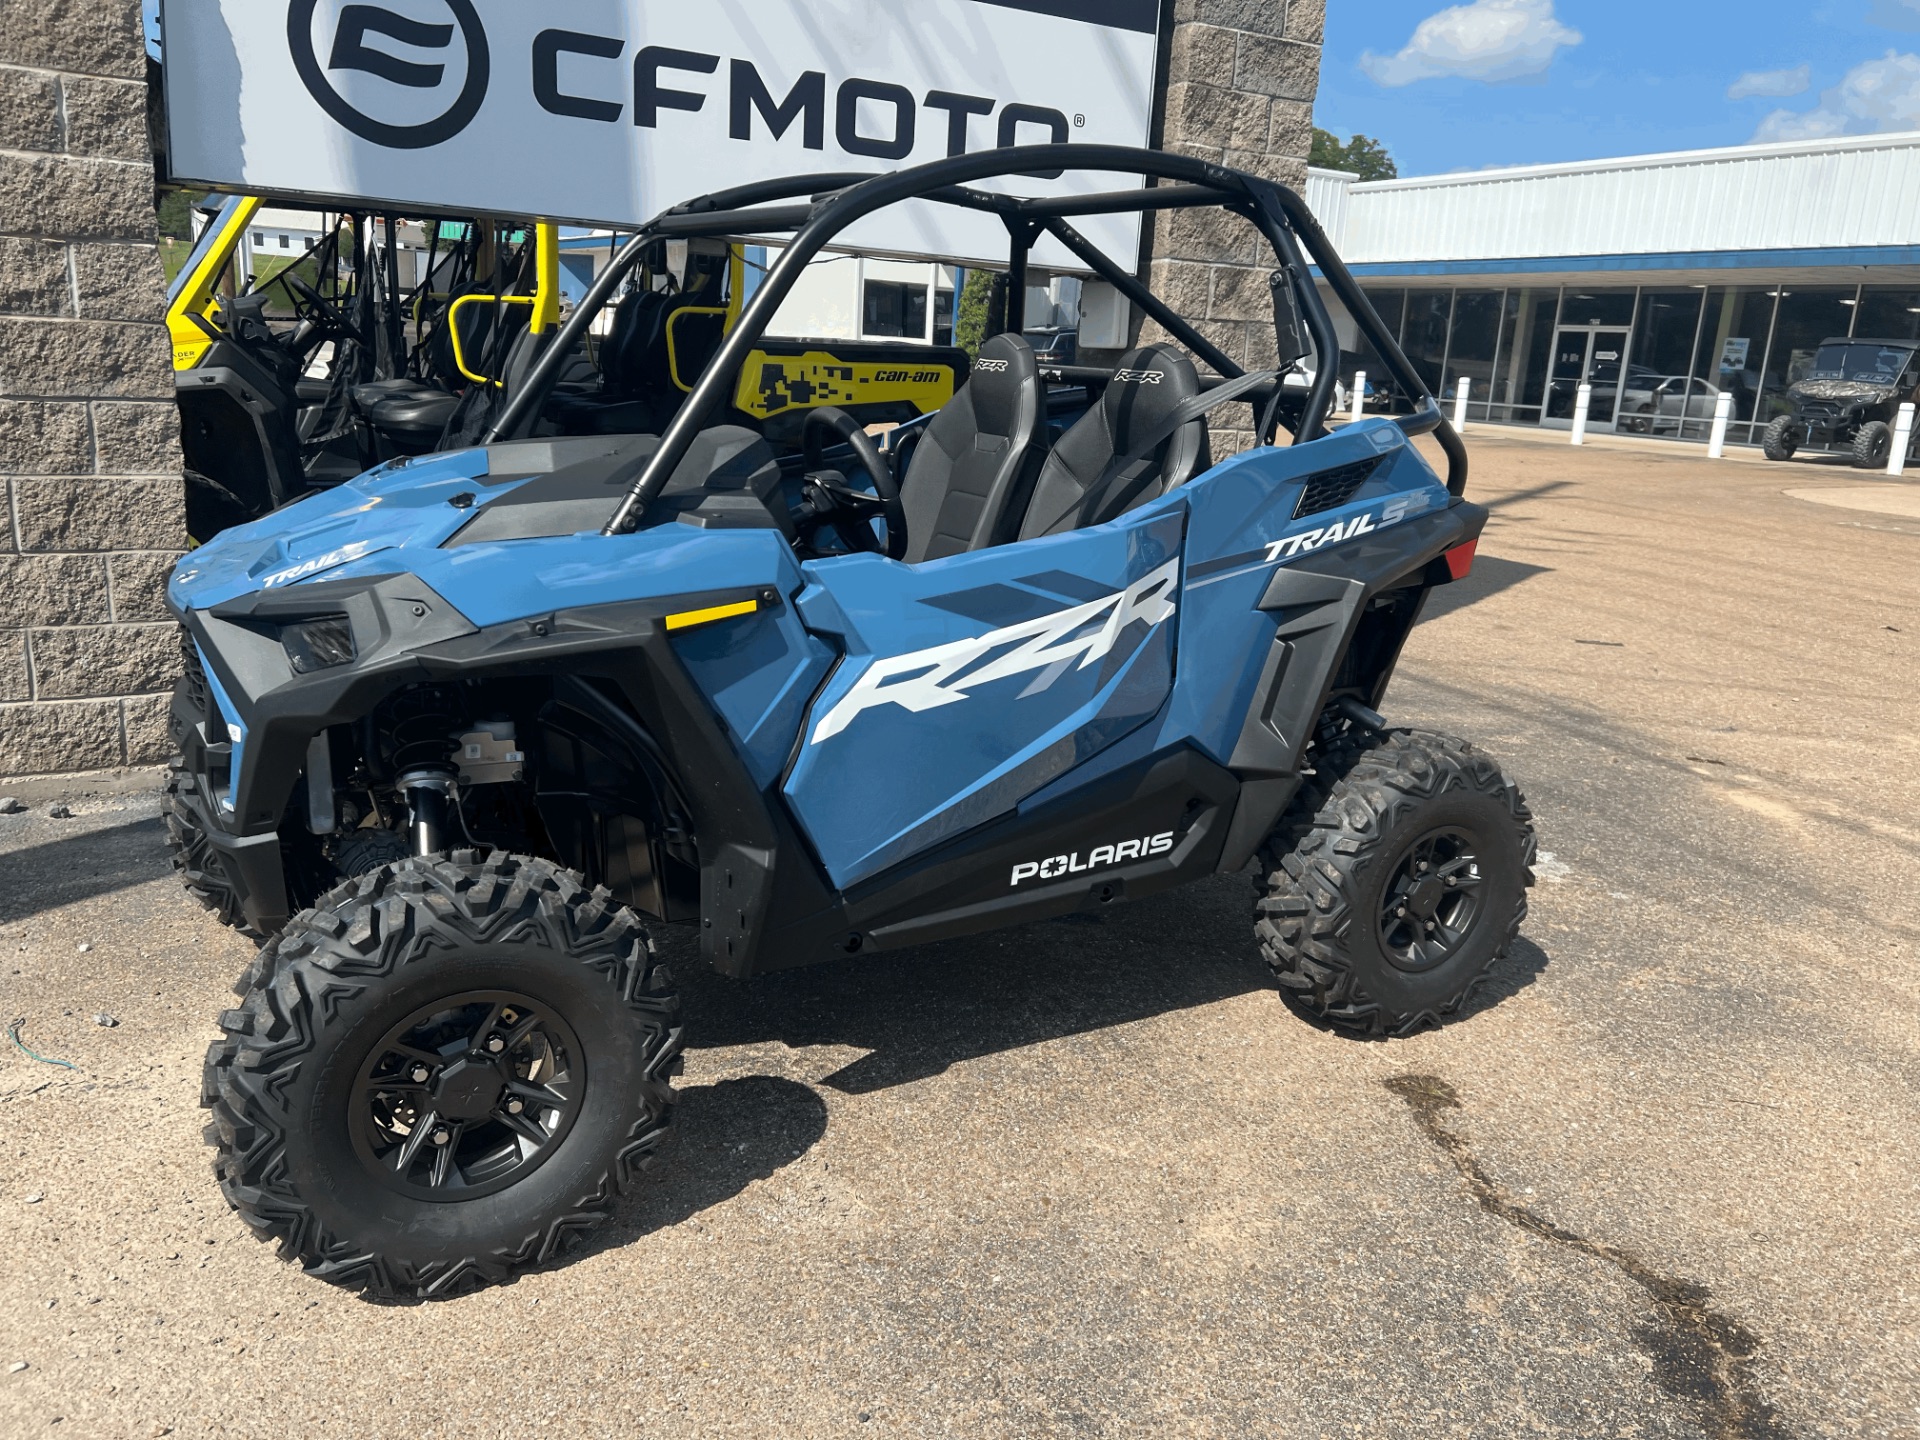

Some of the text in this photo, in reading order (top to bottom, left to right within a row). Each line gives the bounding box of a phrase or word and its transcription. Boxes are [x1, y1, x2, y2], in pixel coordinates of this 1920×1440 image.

[874, 370, 941, 383] can-am
[974, 358, 1008, 372] RZR
[1114, 368, 1165, 384] RZR
[1264, 500, 1409, 562] TRAIL S
[263, 551, 341, 588] TRAIL
[810, 556, 1180, 746] RZR
[1010, 831, 1174, 886] POLARIS
